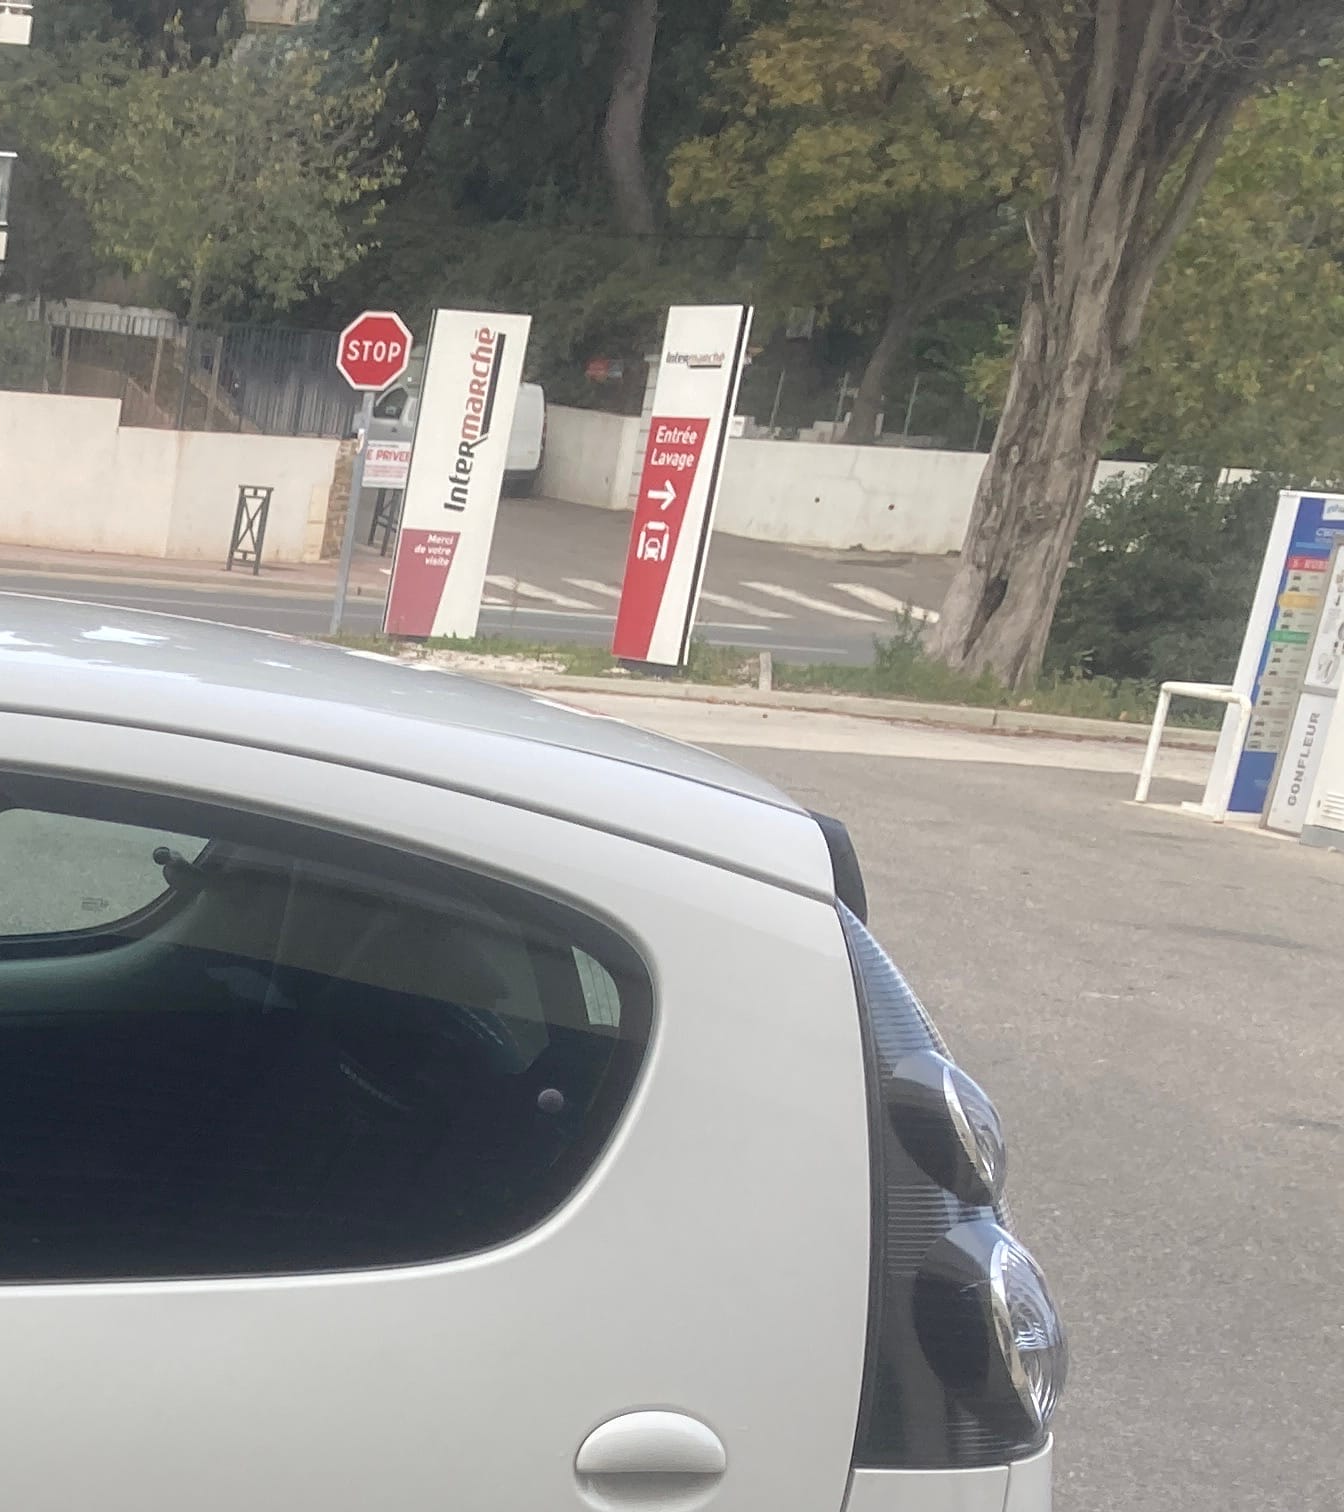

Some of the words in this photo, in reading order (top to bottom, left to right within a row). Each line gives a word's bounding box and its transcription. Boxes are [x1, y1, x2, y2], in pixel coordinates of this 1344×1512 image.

[346, 340, 401, 363] STOP
[443, 326, 497, 513] Intermarché
[655, 425, 698, 445] Entrée
[650, 447, 695, 471] Lavage
[414, 544, 426, 554] de
[428, 547, 451, 556] votre
[427, 534, 454, 545] Merci
[1287, 712, 1320, 806] GONFLEUR
